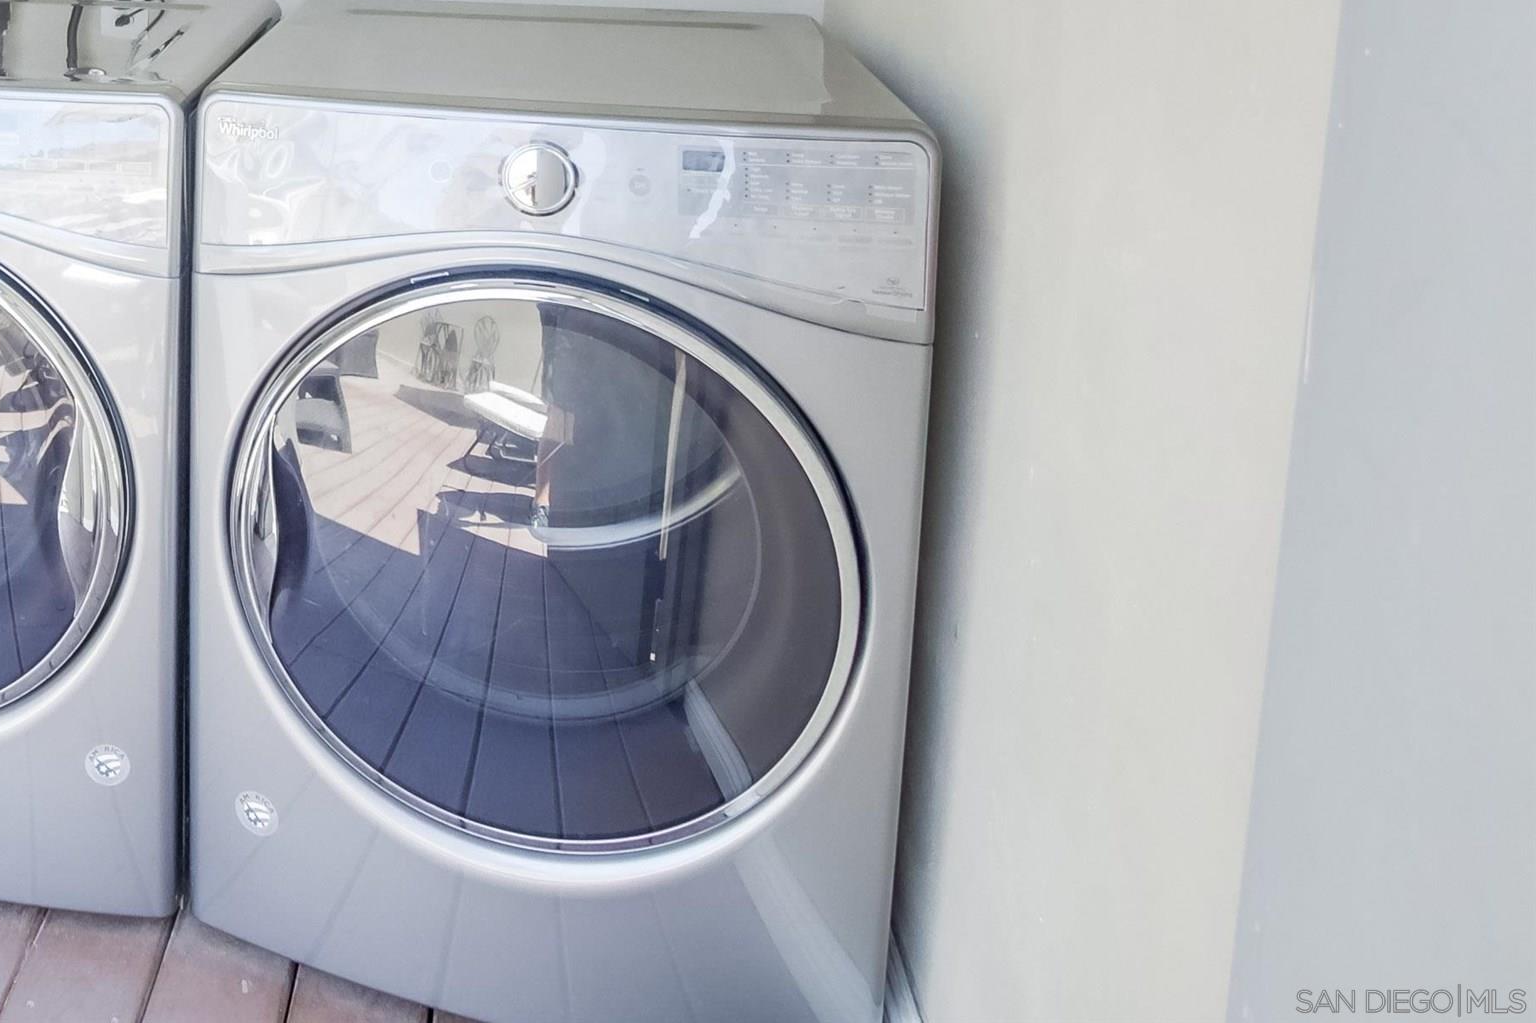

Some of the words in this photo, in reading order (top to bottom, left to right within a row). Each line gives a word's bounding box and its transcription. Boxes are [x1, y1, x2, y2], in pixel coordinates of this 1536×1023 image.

[218, 118, 280, 141] Whirlpool
[88, 744, 125, 762] AMRICA
[239, 793, 275, 814] AMRICA
